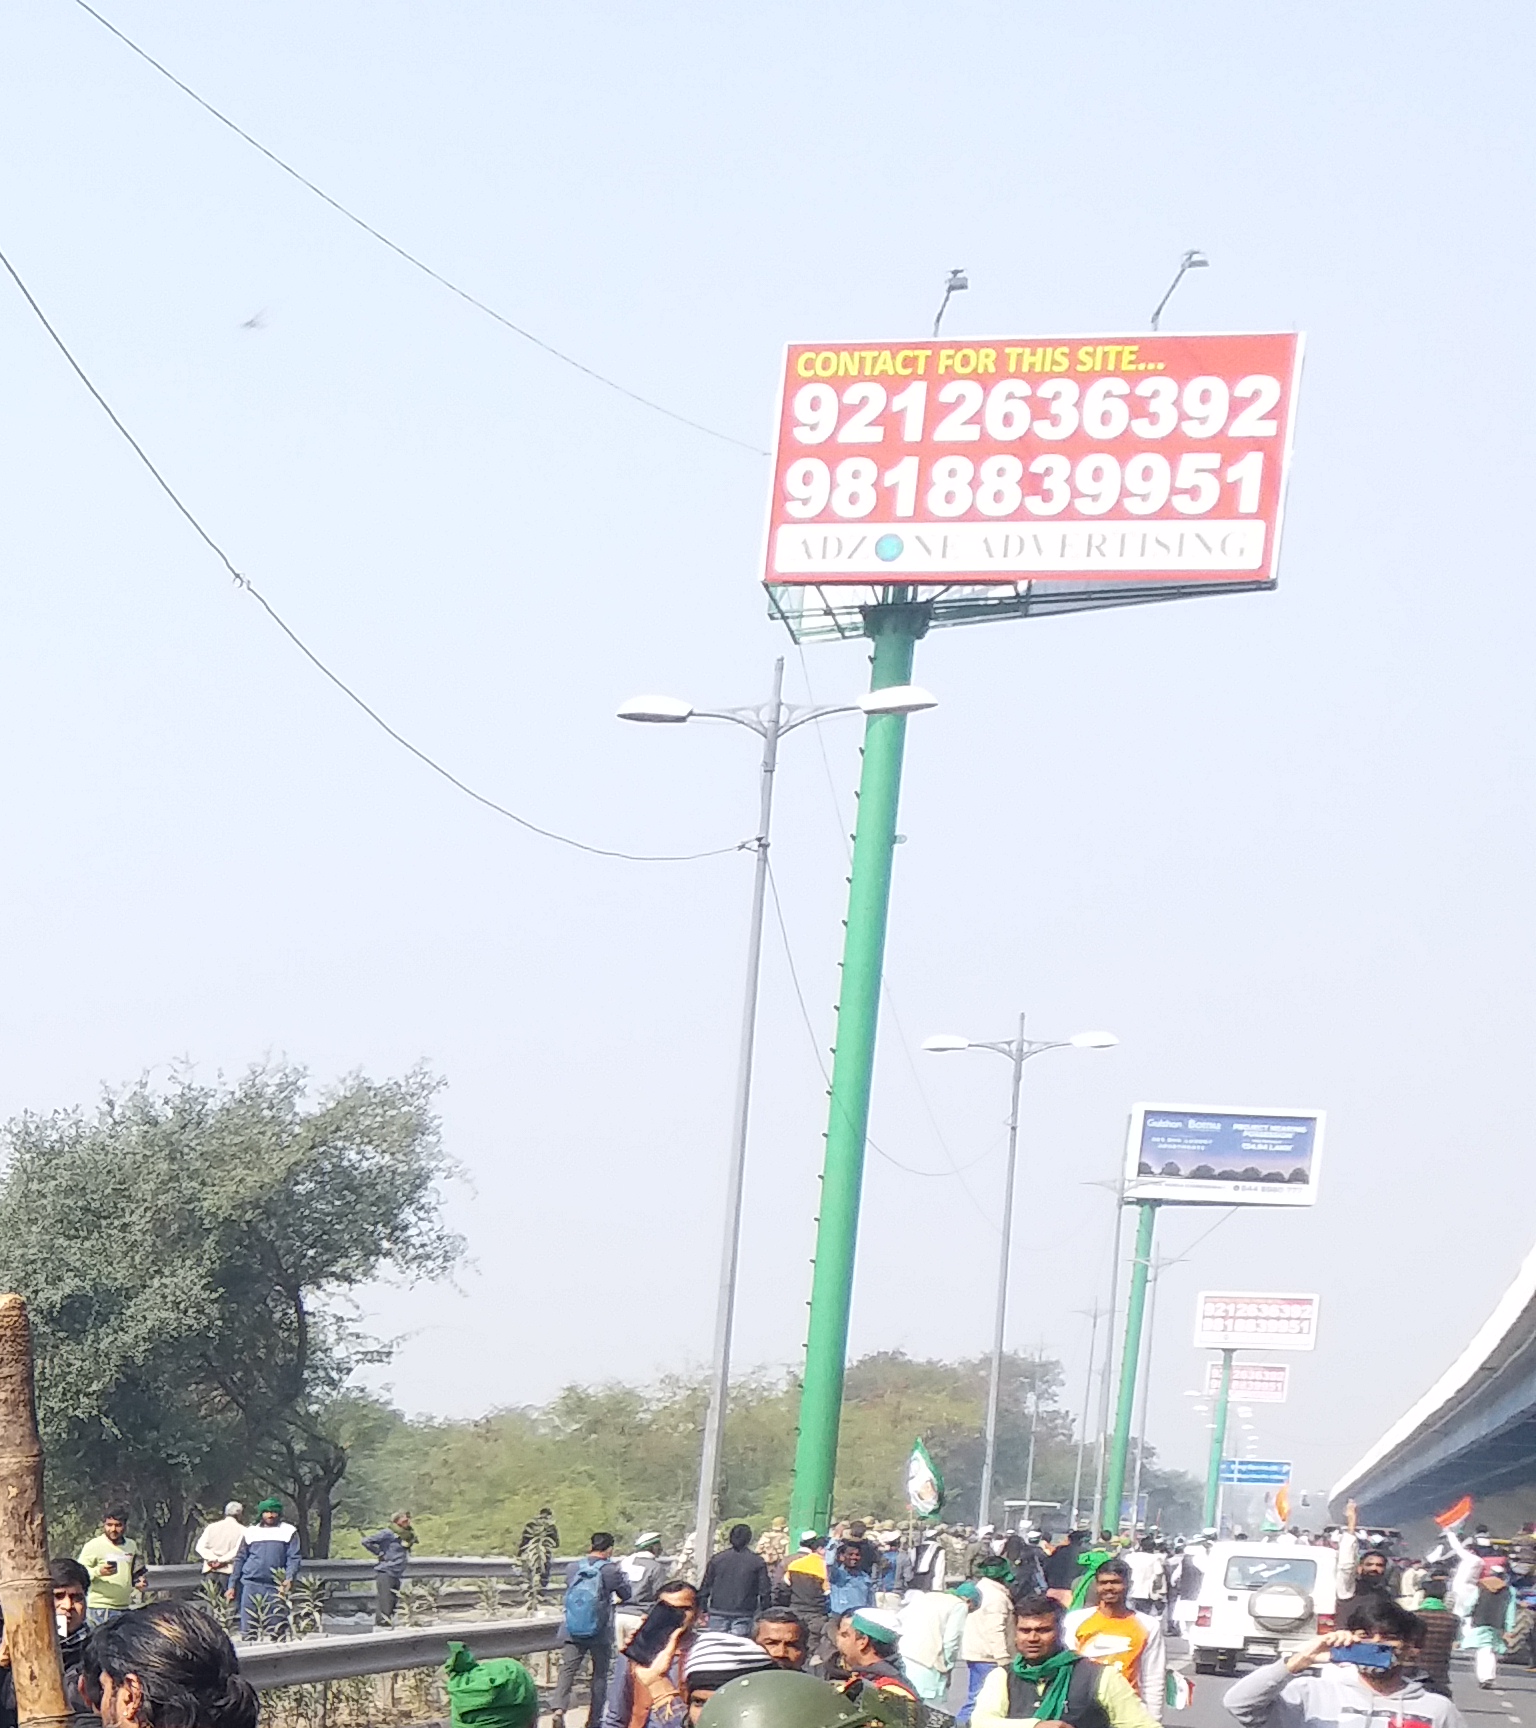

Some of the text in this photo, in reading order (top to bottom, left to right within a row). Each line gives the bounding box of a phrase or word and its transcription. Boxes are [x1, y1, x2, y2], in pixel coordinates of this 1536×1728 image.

[796, 349, 932, 378] CONTACT
[937, 347, 997, 375] FOR
[1004, 346, 1070, 374] THIS
[792, 373, 1281, 445] 9212636392
[784, 450, 1265, 519] 9818839951
[981, 532, 1246, 560] ADVERTISING
